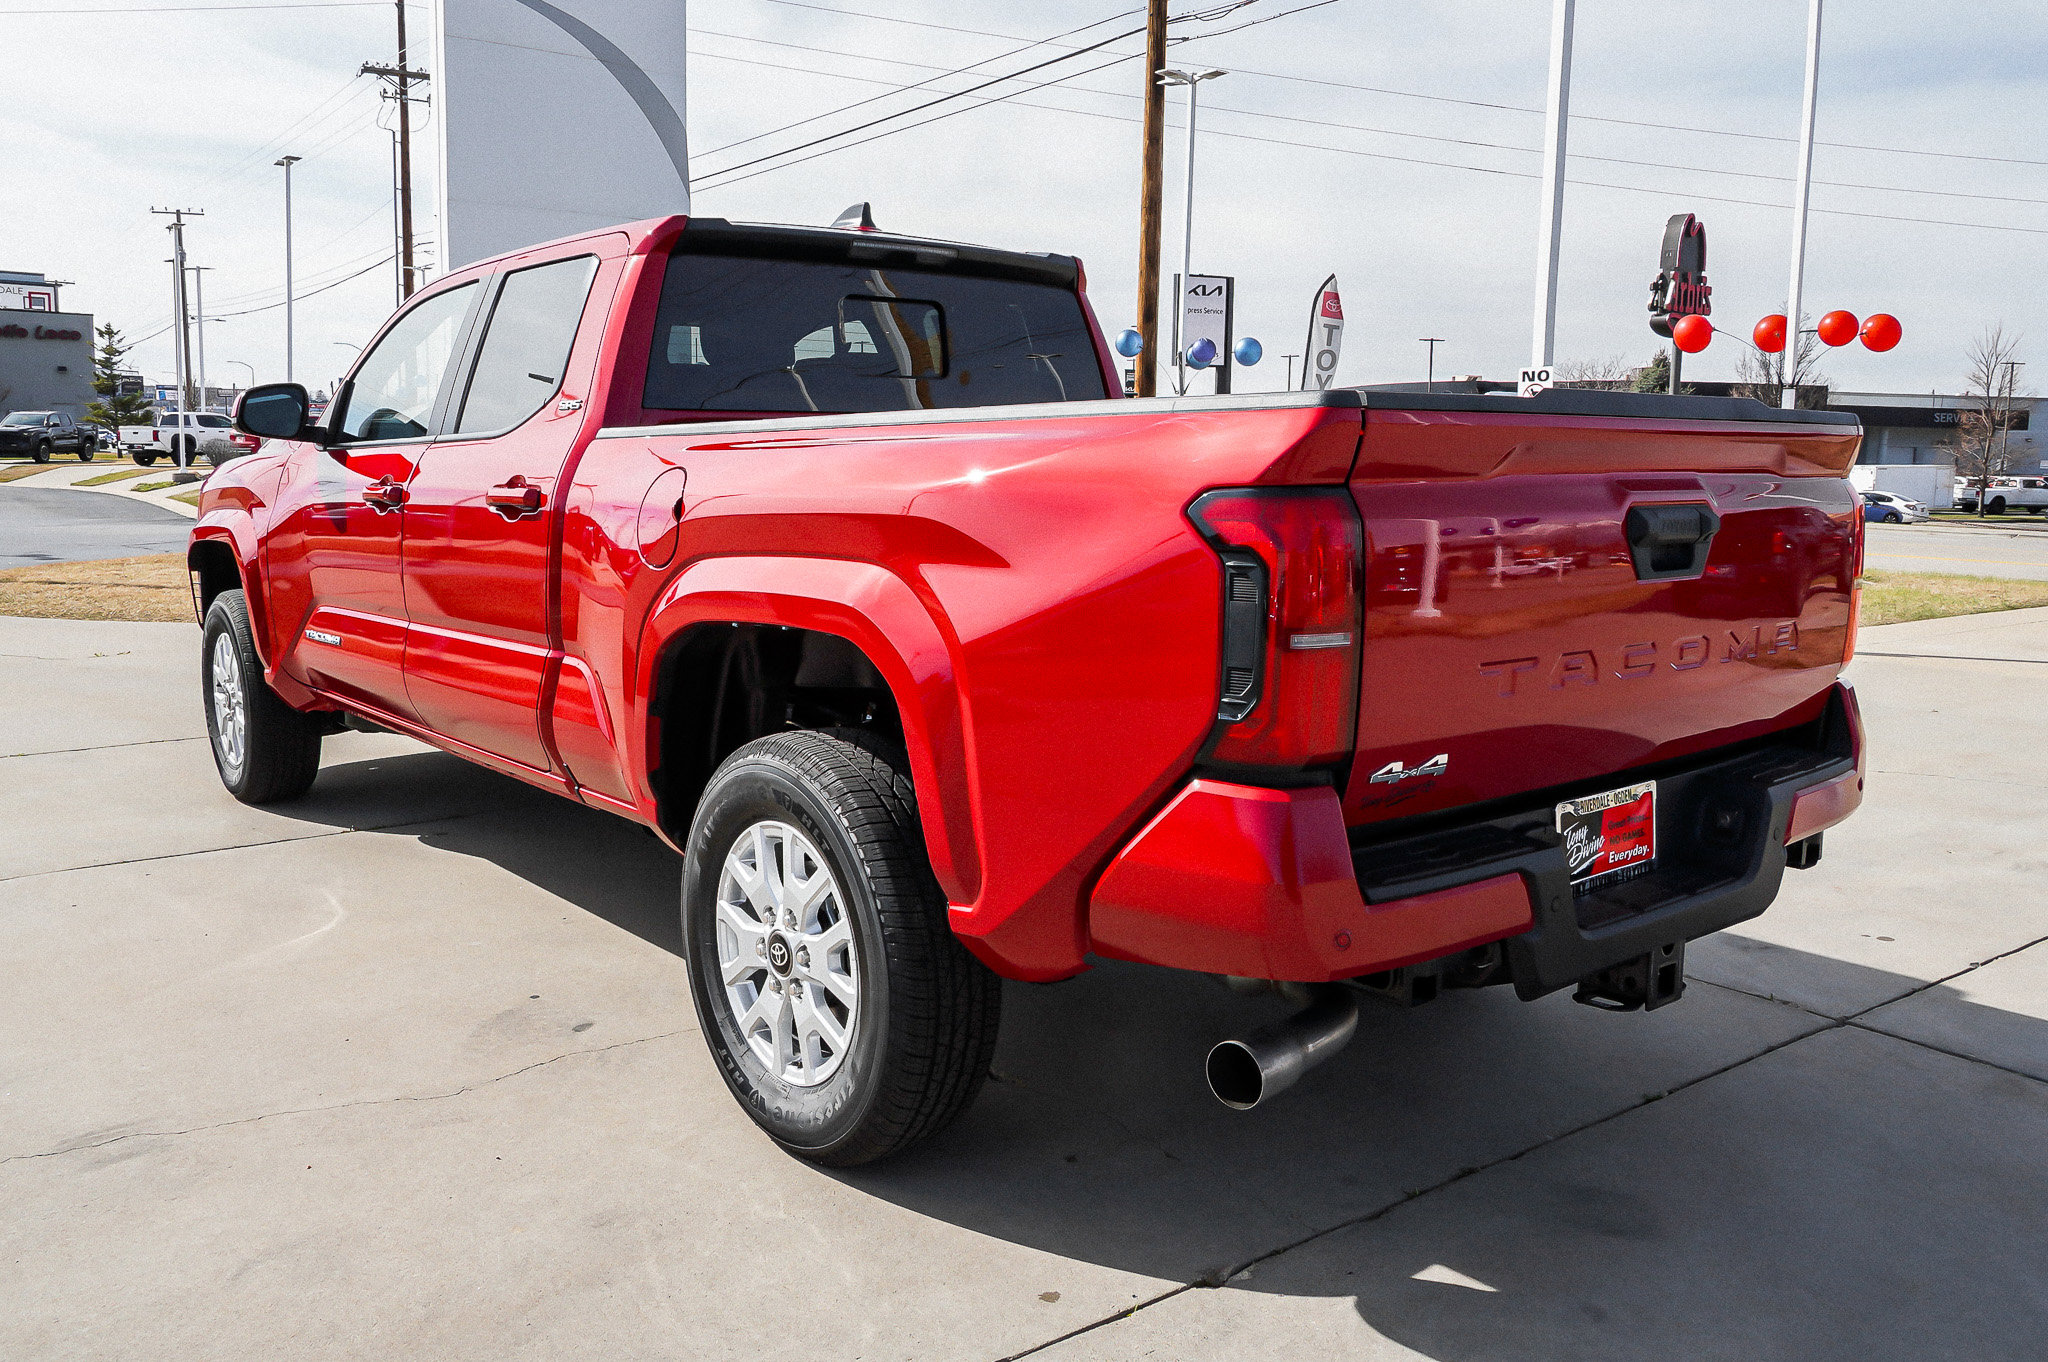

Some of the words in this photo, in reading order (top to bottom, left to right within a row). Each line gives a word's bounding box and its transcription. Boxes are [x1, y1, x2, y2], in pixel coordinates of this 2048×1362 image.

[1522, 370, 1549, 382] NO
[1478, 620, 1800, 698] TACOMA
[1563, 821, 1588, 849] Tony
